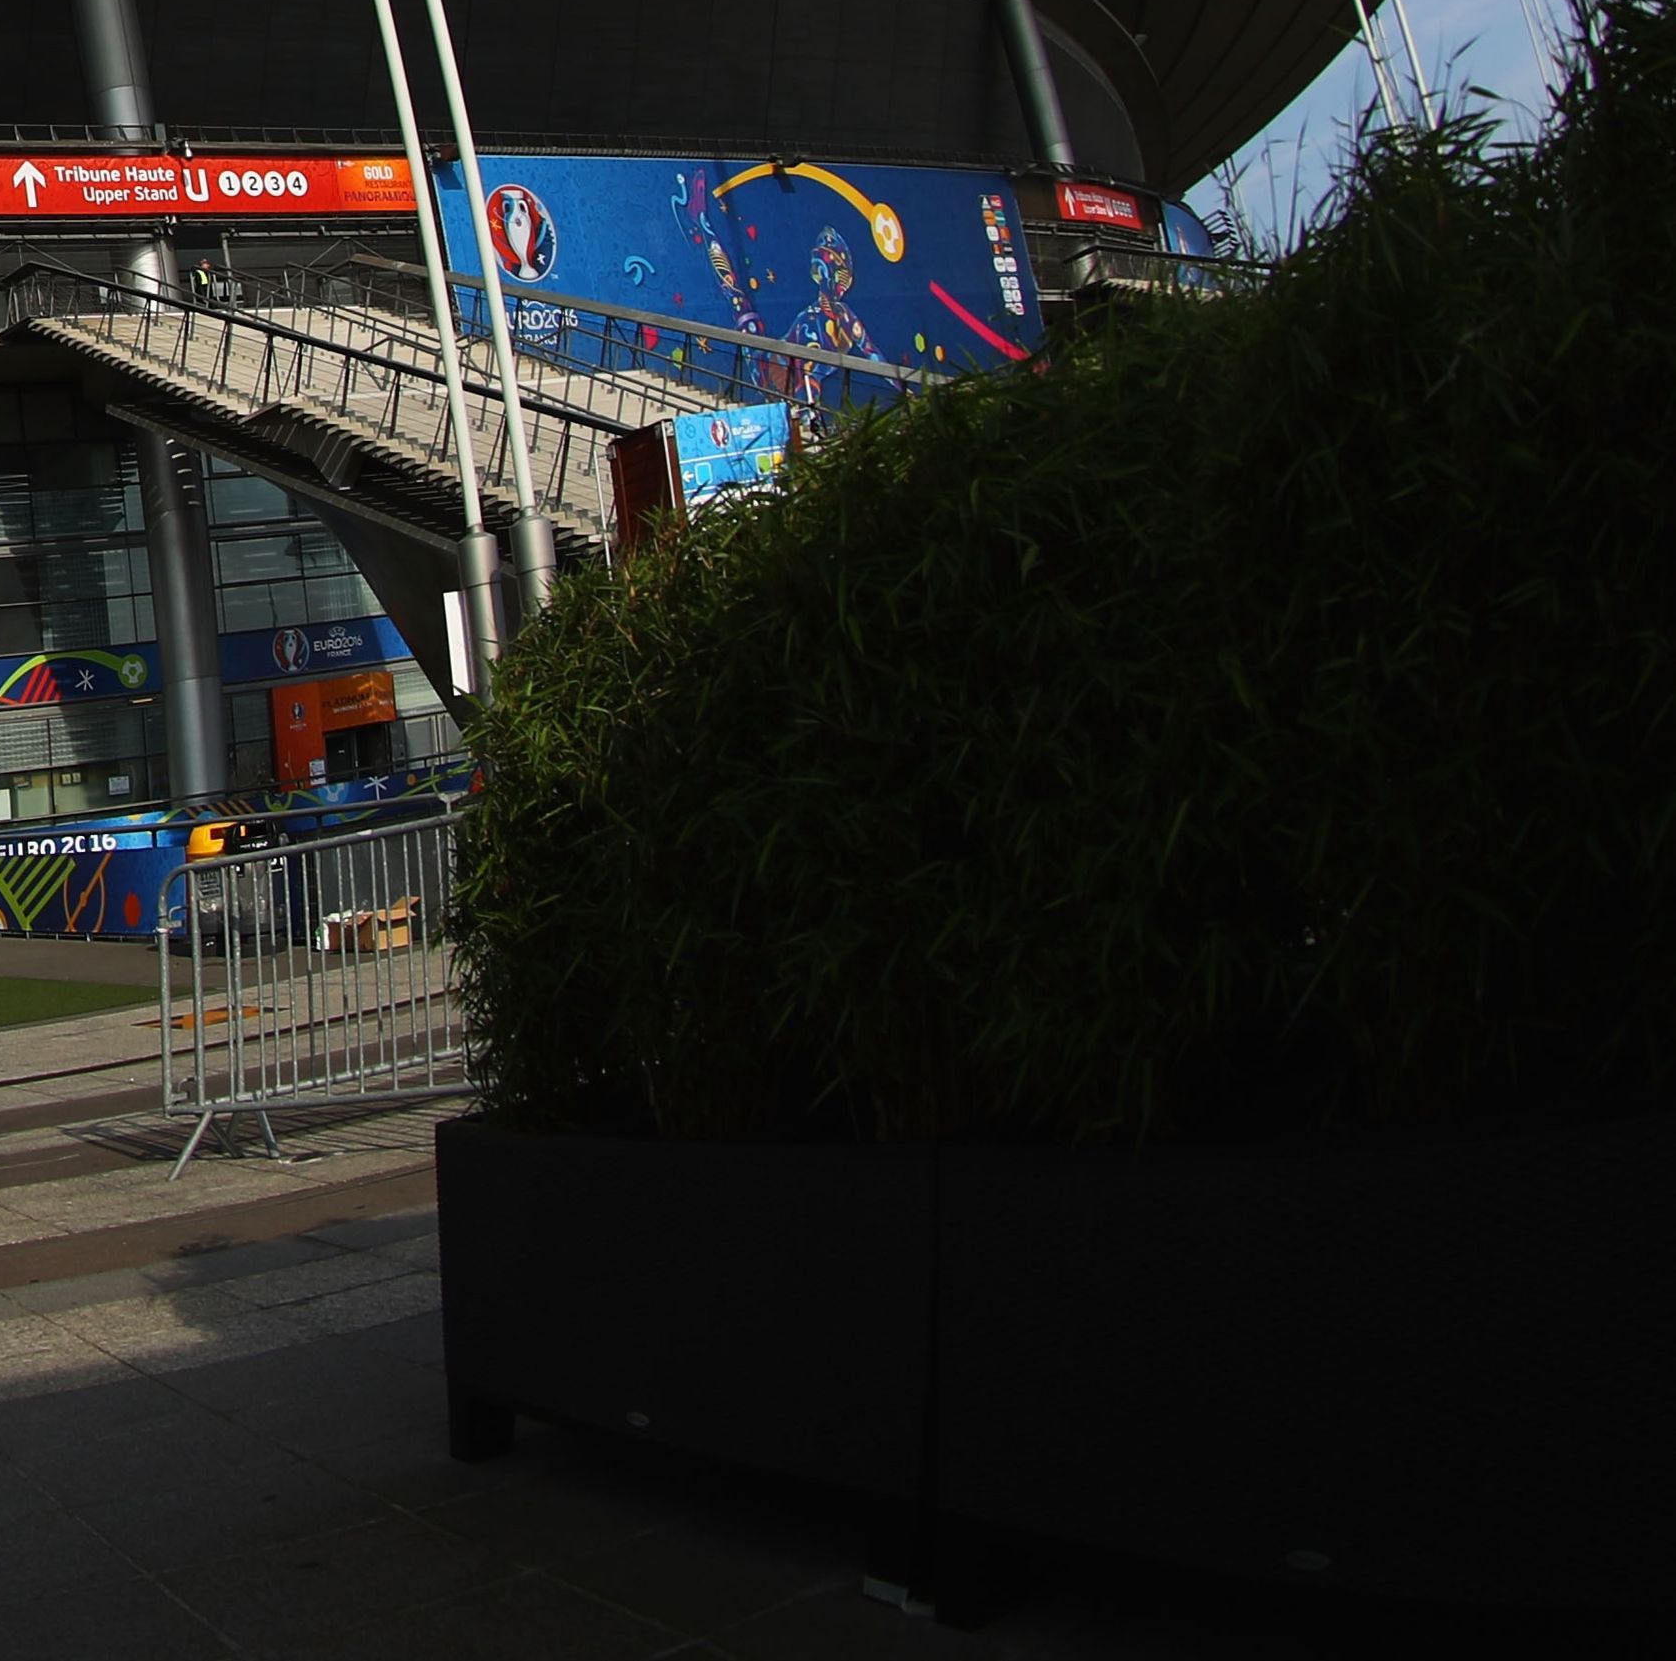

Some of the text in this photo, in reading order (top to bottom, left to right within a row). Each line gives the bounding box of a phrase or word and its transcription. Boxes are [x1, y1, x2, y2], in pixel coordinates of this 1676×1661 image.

[54, 166, 175, 182] Tribune Haute
[363, 165, 394, 180] GOLD
[183, 168, 209, 202] U
[248, 176, 258, 191] 2
[271, 176, 280, 191] 3
[292, 177, 303, 191] 4
[82, 186, 178, 205] Upper Stand
[313, 634, 363, 652] EURO2016
